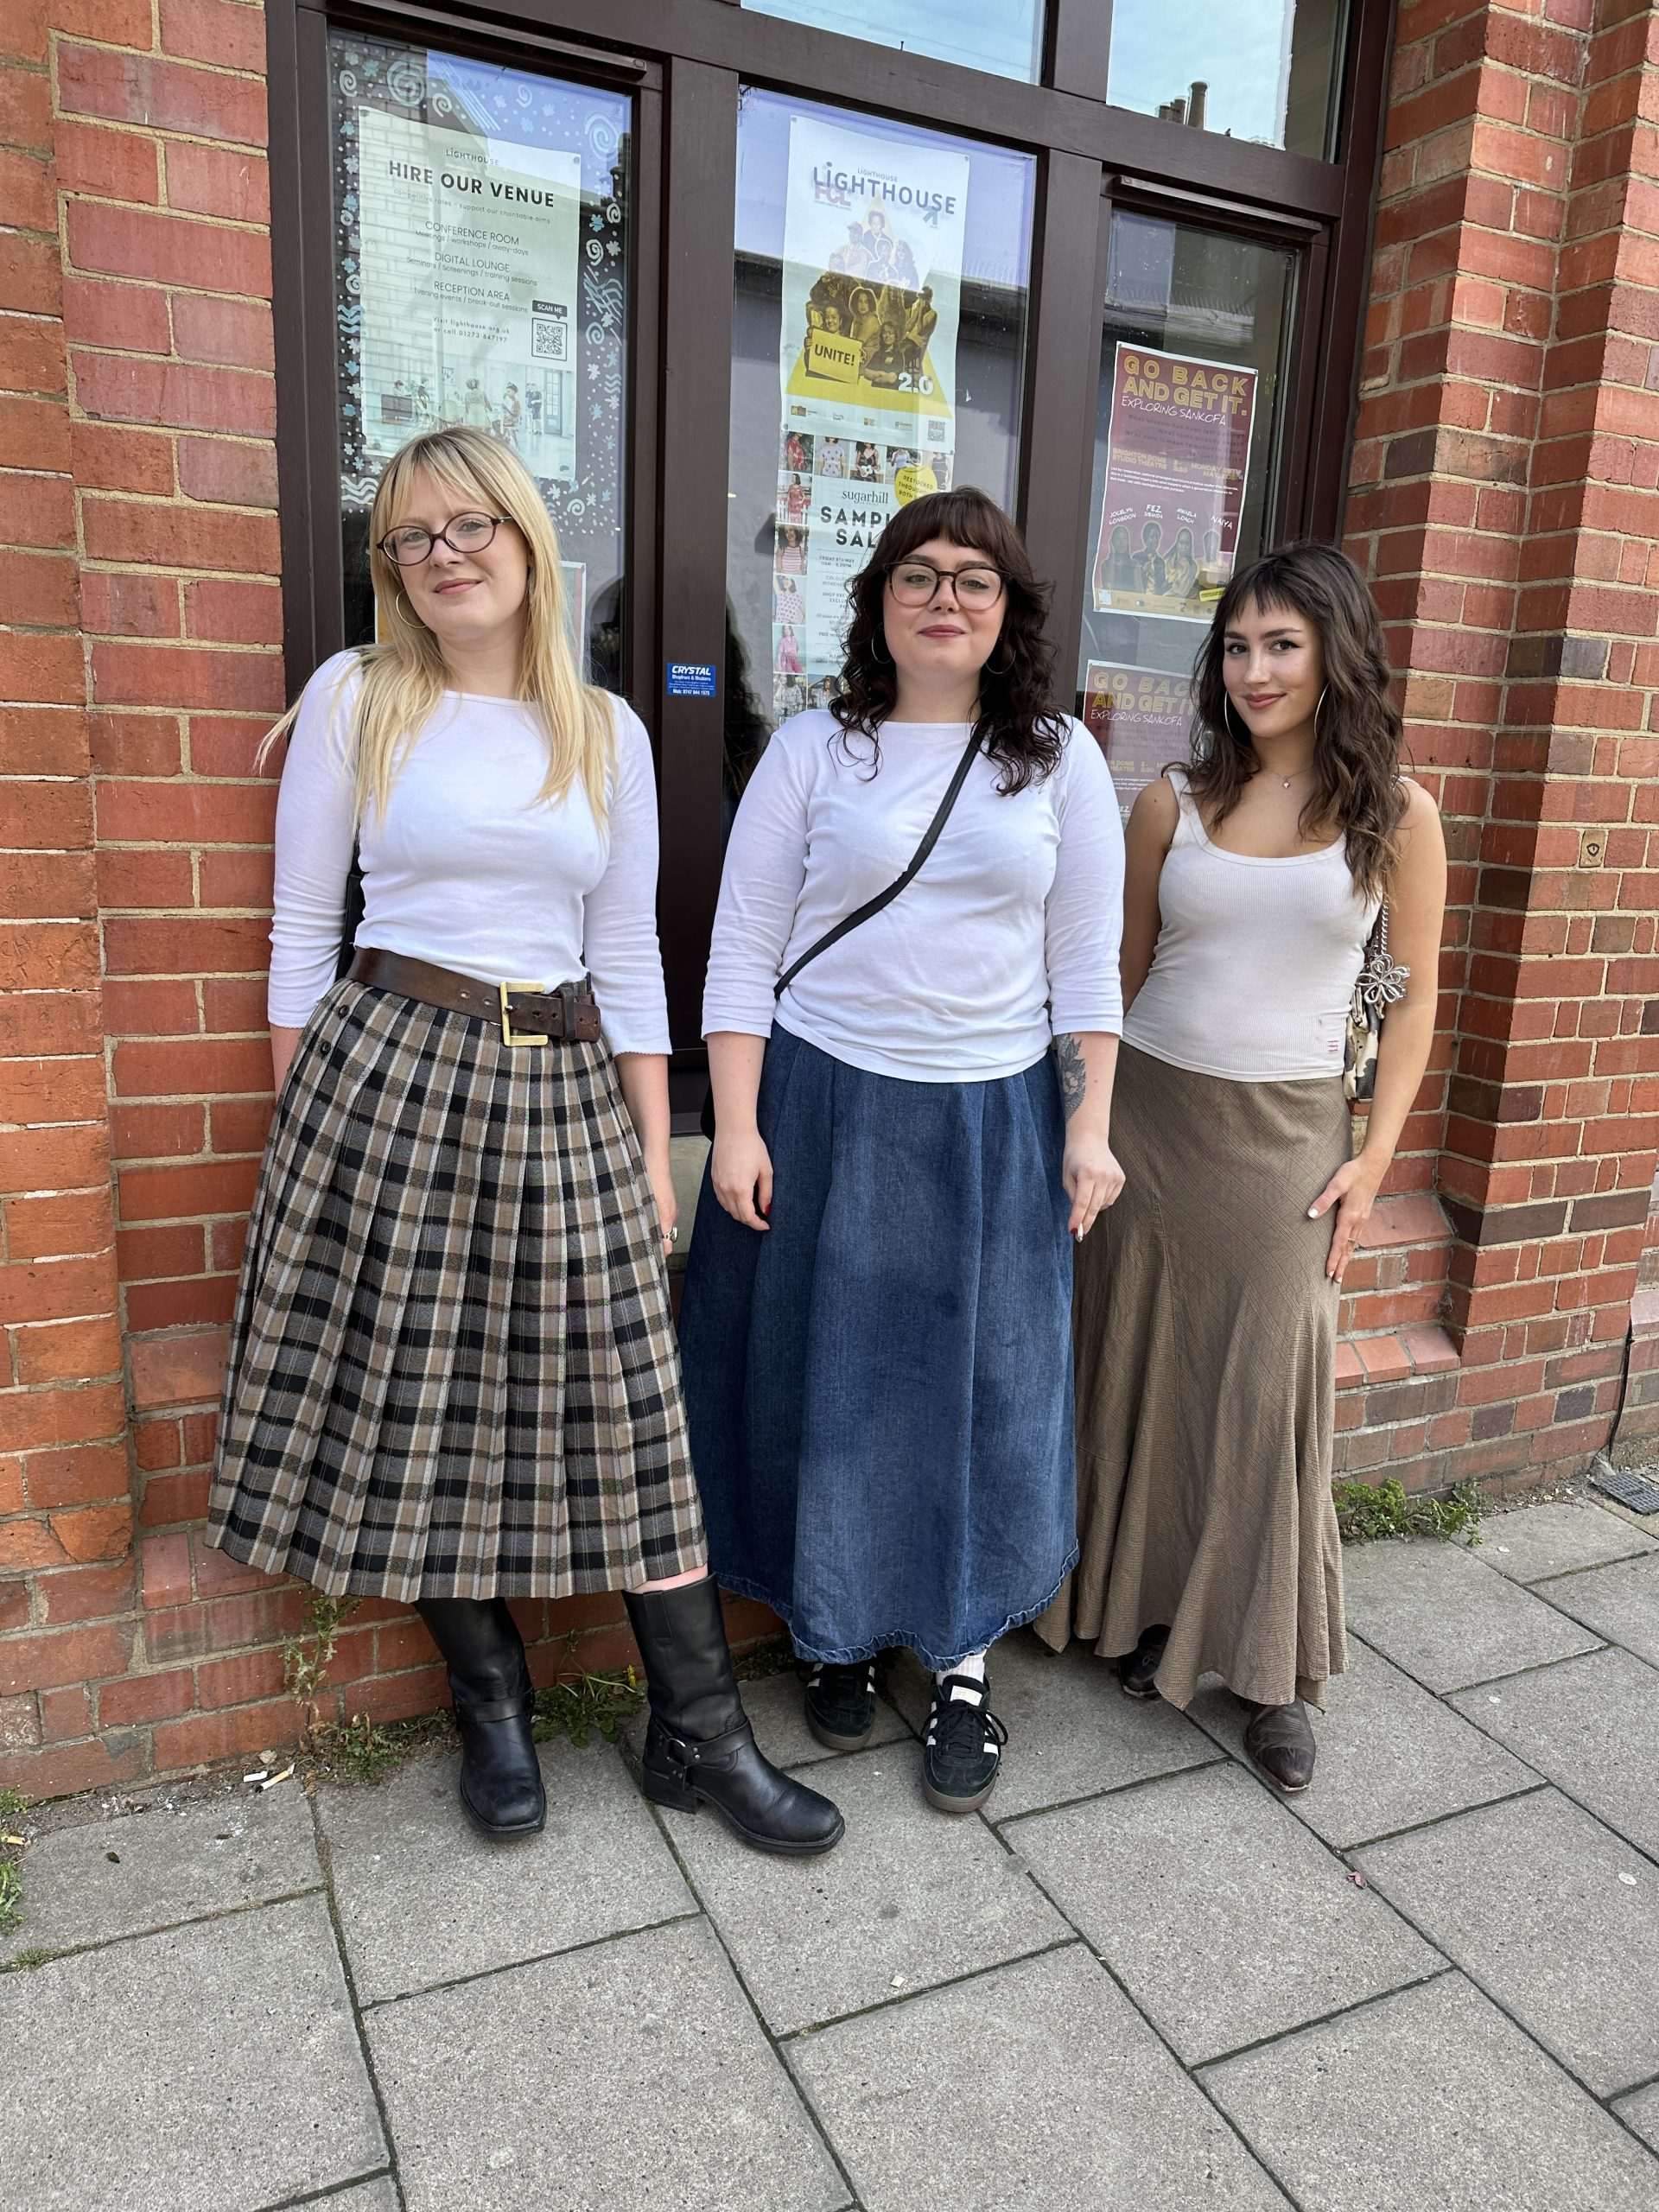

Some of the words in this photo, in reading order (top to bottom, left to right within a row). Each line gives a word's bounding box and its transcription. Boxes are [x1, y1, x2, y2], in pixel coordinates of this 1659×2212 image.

[390, 160, 433, 184] HIRE
[441, 173, 482, 194] OUR
[491, 182, 554, 207] VENUE
[425, 221, 487, 240] CONFERENCE
[490, 232, 519, 245] ROOM
[451, 237, 486, 250] workshops
[435, 252, 470, 267] DIGITAL
[472, 259, 511, 272] LOUNGE
[485, 271, 510, 283] training
[512, 276, 537, 287] sessions
[434, 281, 485, 297] RECEPTION
[487, 289, 511, 301] AREA
[440, 294, 461, 302] events
[502, 302, 528, 313] sessions
[537, 303, 554, 313] SCAN
[814, 344, 855, 366] UNITE!
[898, 372, 934, 396] 2.0
[1124, 355, 1160, 379] GO
[1173, 365, 1249, 397] BACK
[1123, 377, 1169, 401] AND
[1174, 387, 1217, 410] GET
[1221, 395, 1247, 416] IT.
[1180, 408, 1226, 426] SANKOFA
[842, 490, 888, 504] sugarhill
[1147, 504, 1162, 512] FEZ
[836, 529, 877, 548] SAL
[671, 665, 711, 676] CRYSTAL
[1093, 671, 1128, 691] GO
[1139, 677, 1191, 697] BAC
[1092, 691, 1135, 710] AND
[1139, 695, 1176, 714] GET
[1143, 715, 1182, 728] SANKOFA
